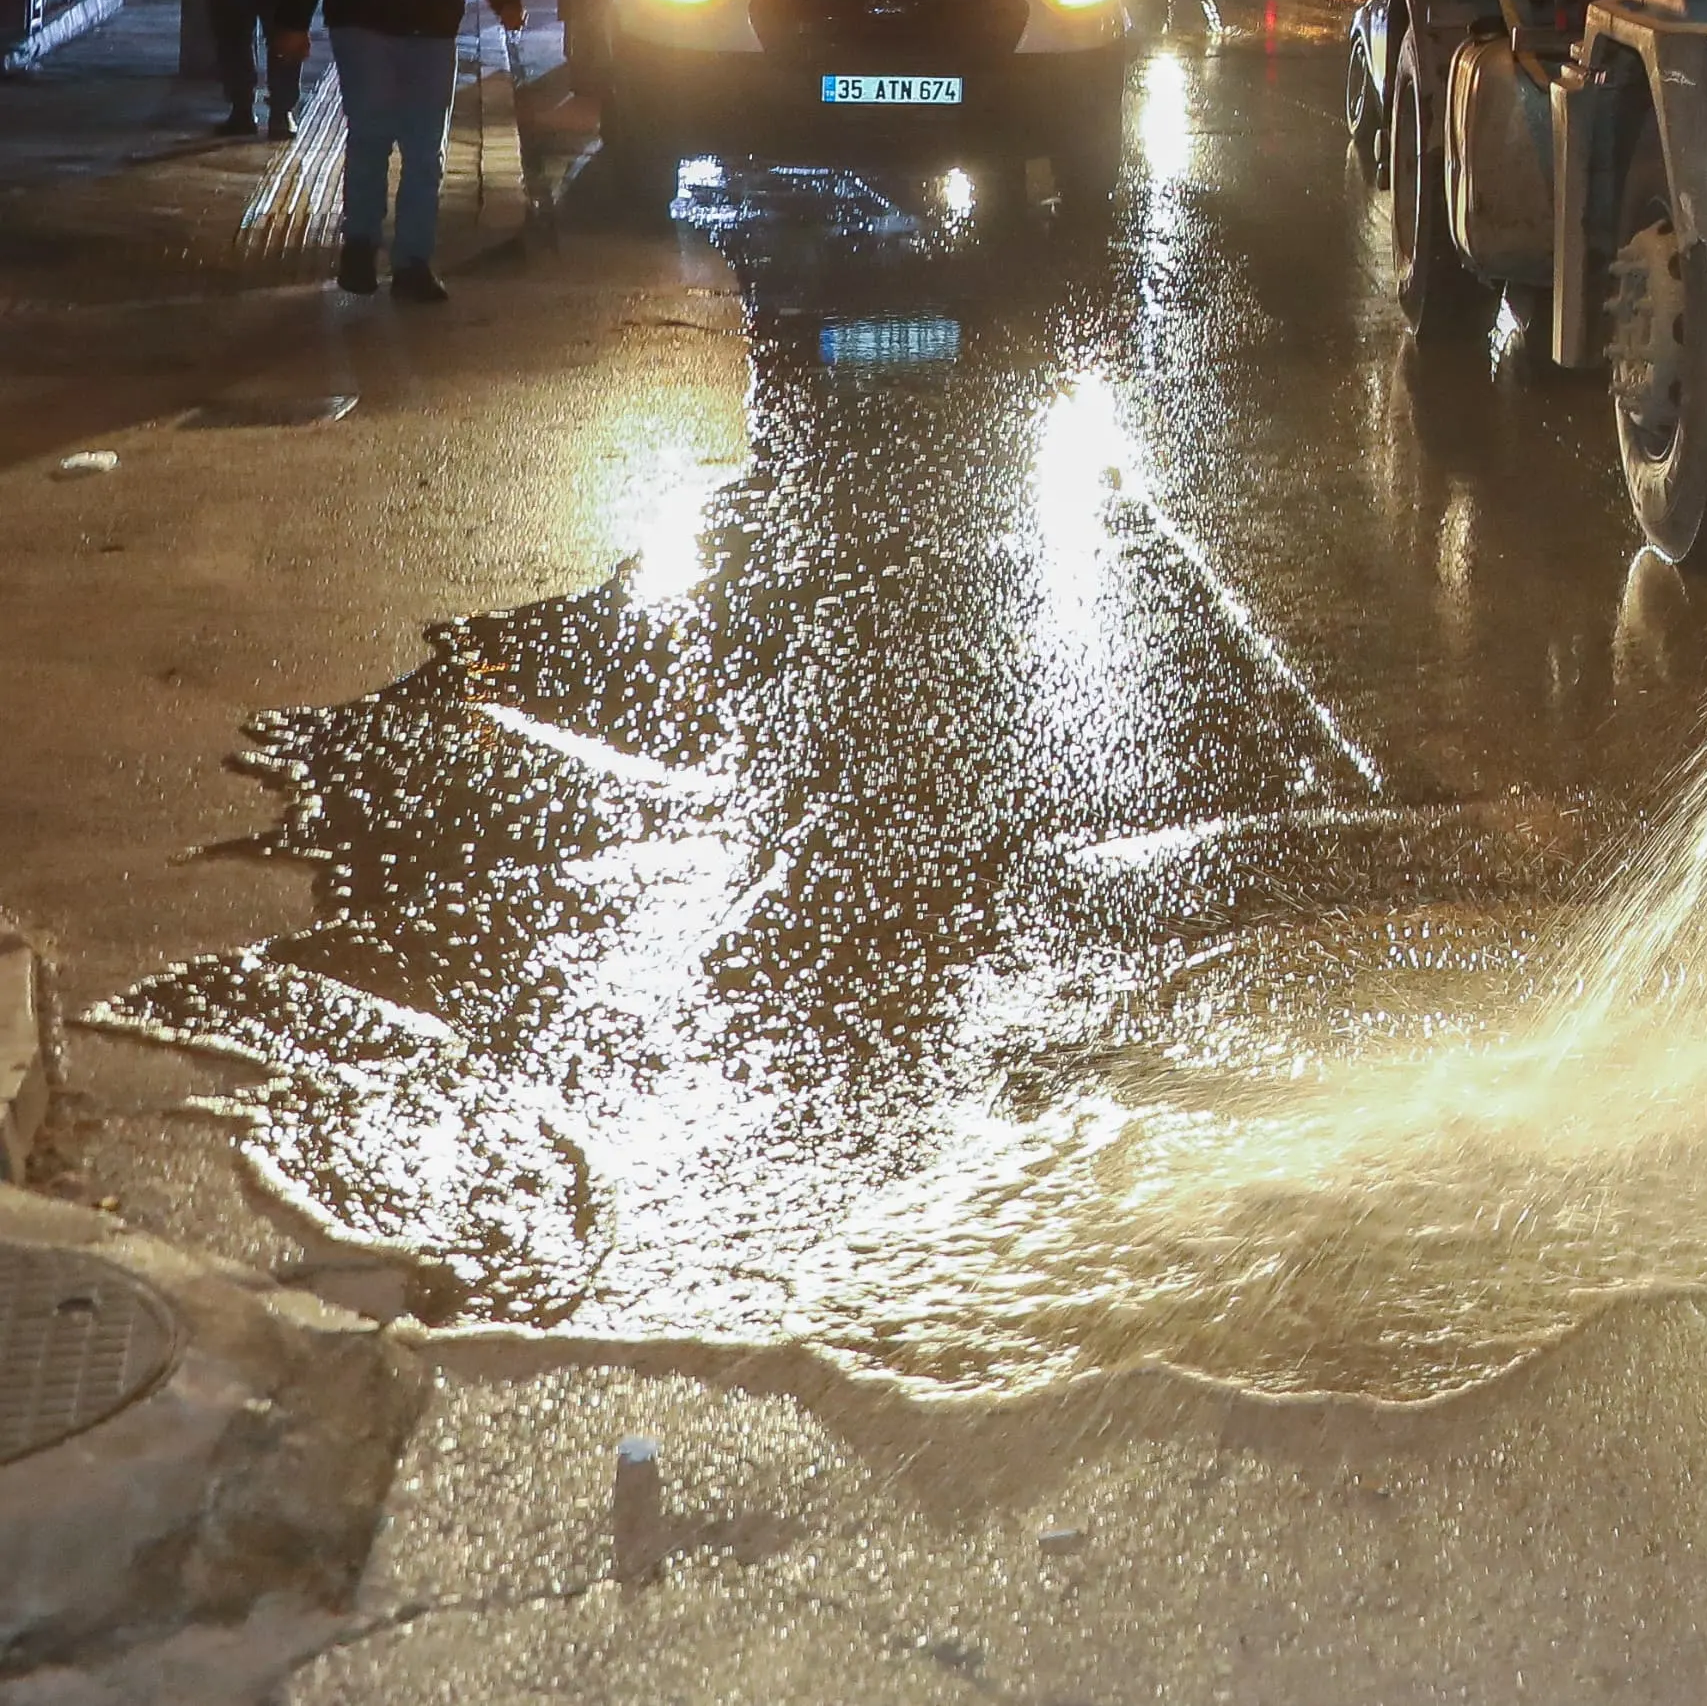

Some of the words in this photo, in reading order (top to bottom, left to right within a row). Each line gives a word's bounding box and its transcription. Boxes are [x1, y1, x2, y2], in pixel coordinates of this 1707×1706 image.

[838, 79, 862, 99] 35
[875, 80, 912, 100] ATN
[919, 81, 956, 101] 674
